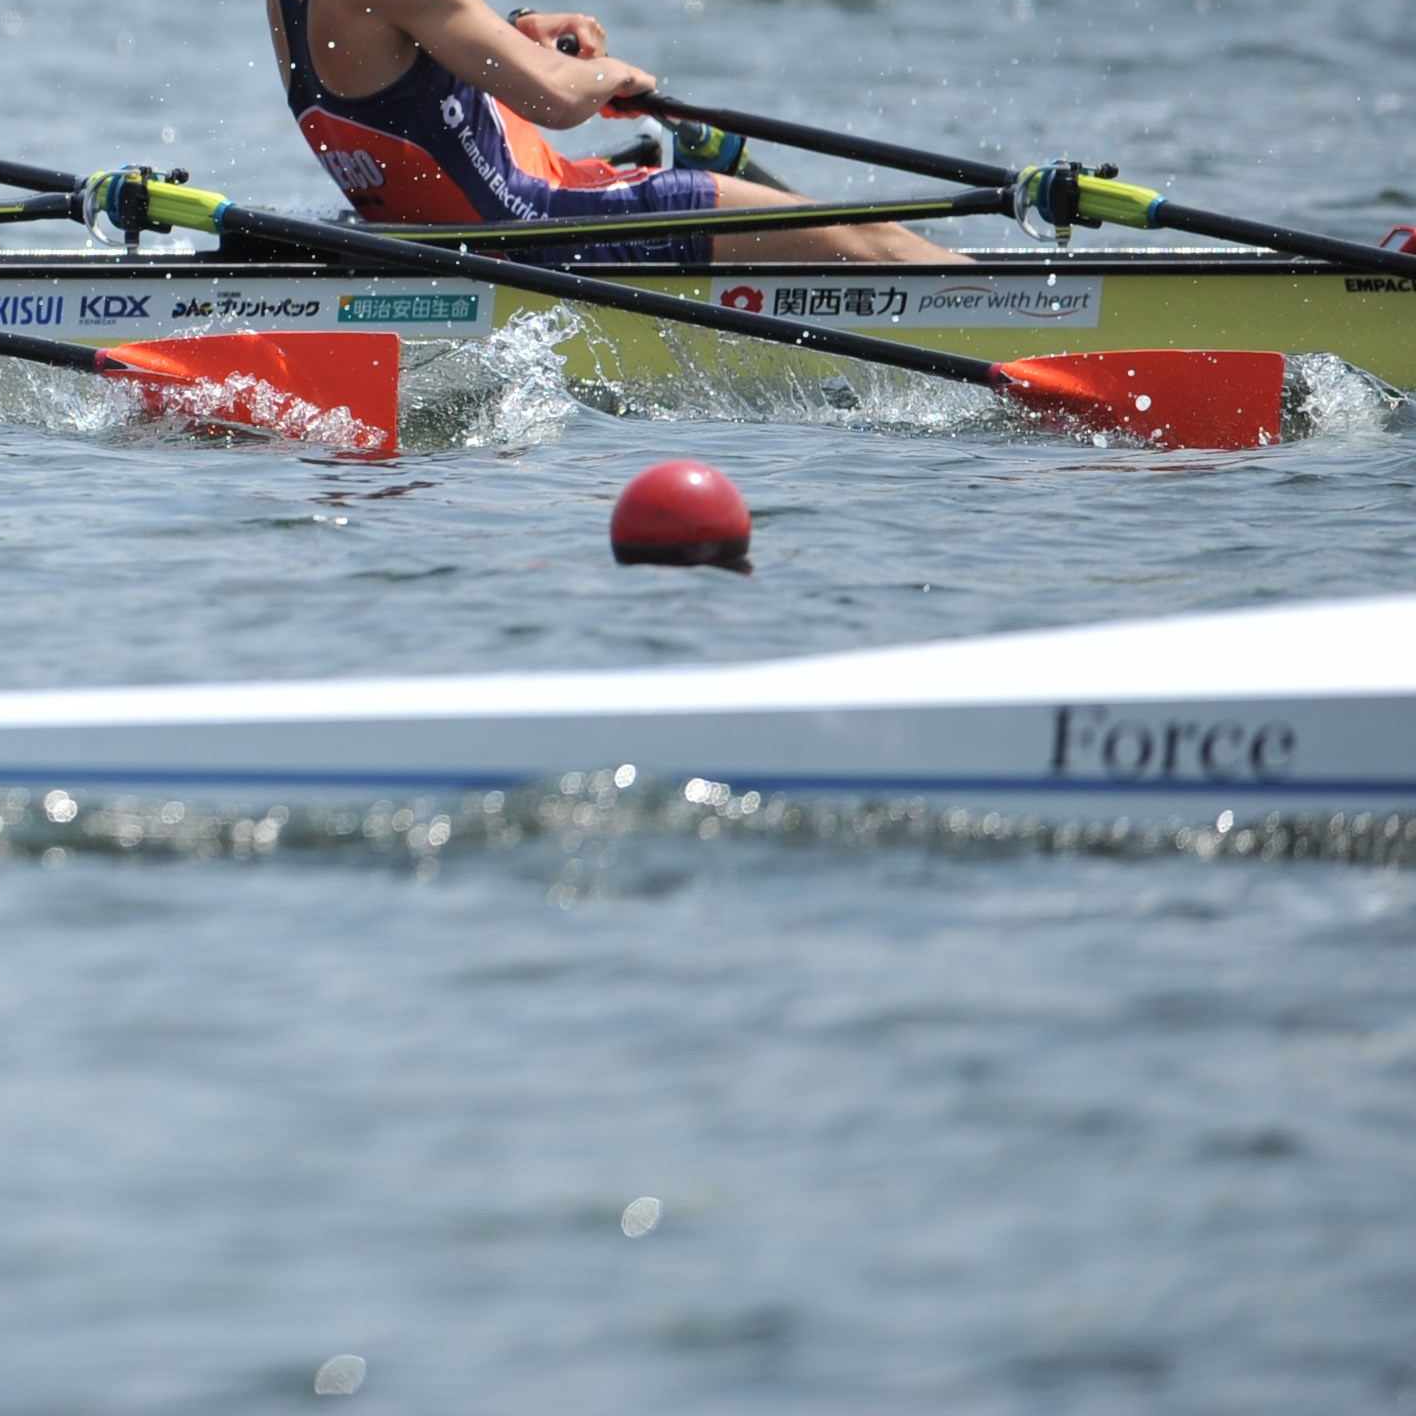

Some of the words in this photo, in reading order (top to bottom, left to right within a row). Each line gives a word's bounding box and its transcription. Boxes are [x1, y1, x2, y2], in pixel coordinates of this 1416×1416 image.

[1344, 278, 1416, 294] EMPAC
[79, 295, 152, 318] KDX
[353, 297, 470, 320] 明治安田生命
[774, 286, 909, 317] 関西電力
[919, 292, 985, 312] power
[988, 289, 1032, 310] with
[1035, 290, 1090, 310] heart
[1048, 703, 1298, 783] Force
